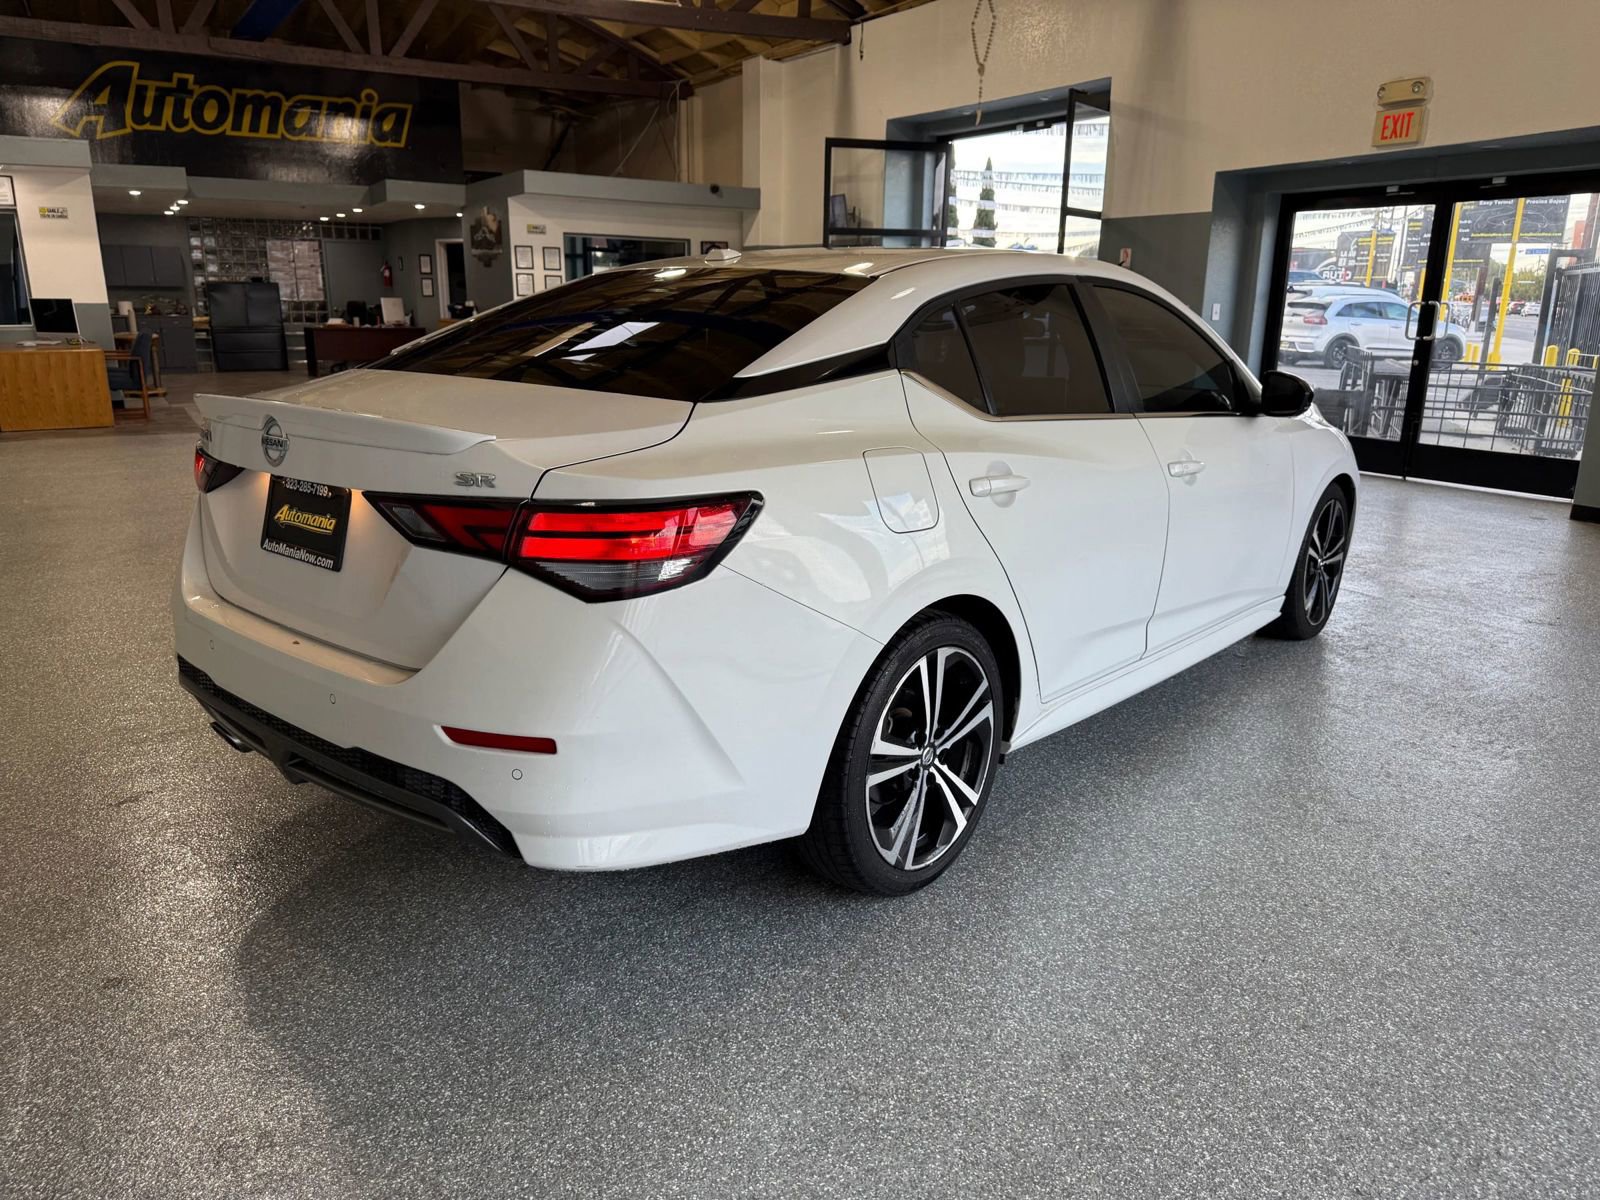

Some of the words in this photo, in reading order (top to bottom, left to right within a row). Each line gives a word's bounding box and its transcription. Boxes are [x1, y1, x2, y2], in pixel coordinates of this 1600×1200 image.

[50, 61, 412, 147] Automania
[1380, 111, 1415, 141] EXIT
[285, 478, 329, 497] 323-285-7199
[454, 471, 496, 489] SR
[274, 503, 337, 533] Automania
[262, 538, 334, 569] AutoManiaNow.com
